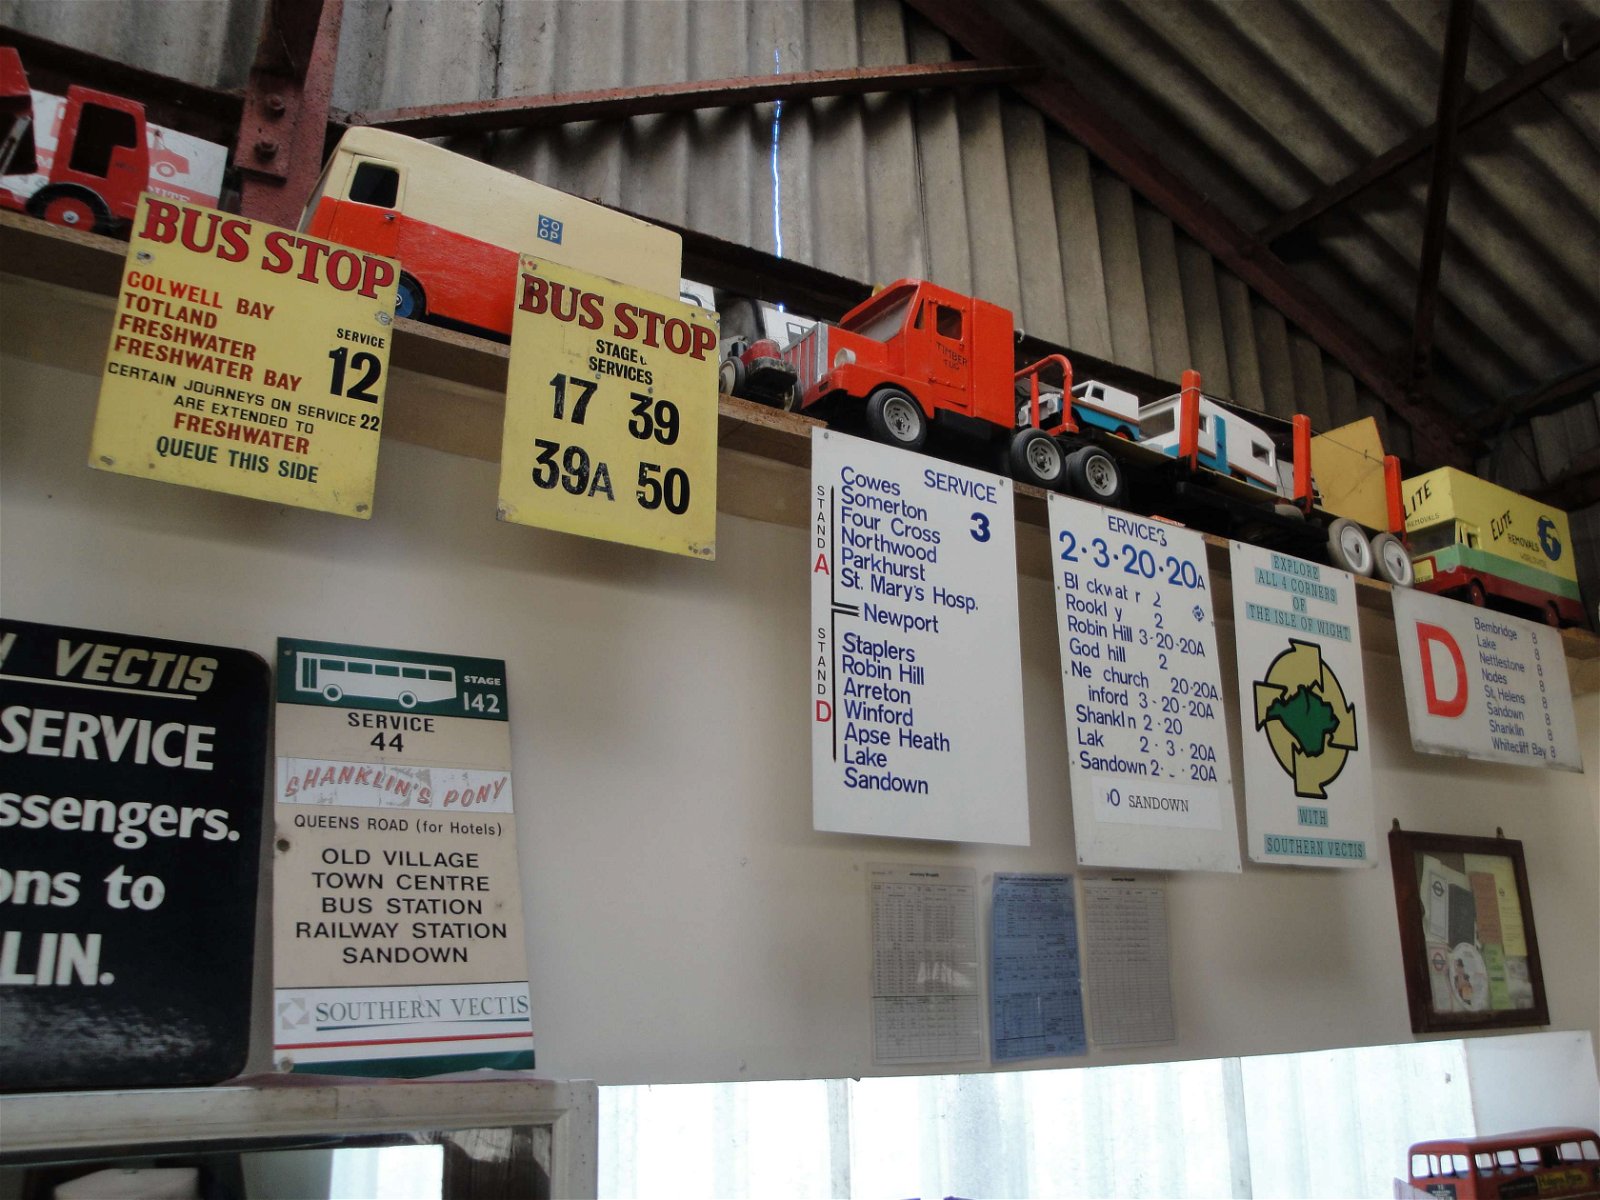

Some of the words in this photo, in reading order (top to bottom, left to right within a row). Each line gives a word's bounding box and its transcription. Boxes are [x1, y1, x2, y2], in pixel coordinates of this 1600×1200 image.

[138, 196, 252, 262] BUS
[261, 230, 394, 300] STOP
[127, 271, 223, 309] COLWELL
[236, 298, 275, 321] BAY
[124, 292, 218, 329] TOTLAND
[519, 273, 605, 331] BUS
[614, 302, 717, 362] STOP
[119, 313, 257, 361] FRESHWATER
[336, 327, 385, 349] SERVICE
[596, 339, 638, 363] STAGE
[114, 334, 254, 382] FRESHWATER
[263, 369, 302, 392] BAY
[328, 346, 382, 404] 12
[589, 356, 653, 385] SERVICES
[108, 362, 177, 387] CERTAIN
[184, 379, 265, 407] JOURNEYS
[271, 398, 291, 412] ON
[297, 404, 356, 427] SERVICE
[360, 413, 381, 432] 22
[549, 372, 598, 425] 17
[173, 395, 205, 411] ARE
[211, 403, 288, 430] EXTENDED
[295, 420, 314, 434] TO
[628, 392, 680, 445] 39
[173, 412, 310, 455] FRESHWATER
[155, 436, 219, 464] QUEUE
[228, 449, 269, 473] THIS
[278, 461, 319, 484] SIDE
[531, 438, 615, 502] 39A
[636, 462, 691, 515] 50
[840, 466, 901, 496] Cowes
[924, 469, 997, 504] SERVICE
[841, 485, 928, 521] Somerton
[841, 506, 881, 530] Four
[891, 518, 941, 544] Cross
[969, 512, 991, 543] 3
[841, 526, 937, 563] Northwood
[1507, 533, 1540, 552] REMOVALS
[814, 553, 830, 575] A
[841, 547, 926, 581] Parkhurst
[1273, 555, 1319, 580] EXPLORE
[840, 568, 864, 590] St.
[871, 576, 925, 602] Mary's
[932, 586, 978, 614] Hosp.
[1258, 569, 1278, 586] ALL
[1281, 576, 1287, 589] 4
[1290, 578, 1336, 602] CORNERS
[1152, 592, 1162, 608] 2
[1292, 597, 1306, 612] OF
[864, 602, 939, 634] Newport
[1067, 615, 1108, 638] Robin
[1113, 624, 1133, 643] Hill
[1154, 613, 1164, 629] 2
[1248, 604, 1271, 622] THE
[1274, 611, 1297, 628] ISLE
[1301, 617, 1314, 631] OF
[1317, 620, 1350, 640] WIGHT
[1474, 617, 1518, 640] Bembridge
[842, 632, 915, 663] Staplers
[1476, 634, 1497, 650] Lake
[55, 638, 219, 692] VECTIS
[842, 654, 892, 680] Robin
[900, 664, 924, 686] Hill
[1158, 653, 1168, 670] 2
[1416, 621, 1468, 718] D
[1479, 650, 1525, 672] Nettlestone
[464, 675, 501, 686] STAGE
[843, 677, 911, 704] Arreton
[1481, 668, 1508, 685] Nodes
[463, 691, 500, 713] 142
[1497, 688, 1525, 704] Helens
[348, 712, 435, 733] SERVICE
[815, 700, 832, 722] D
[844, 699, 914, 727] Winford
[1486, 702, 1524, 720] Sandown
[0, 705, 216, 771] SERVICE
[370, 732, 404, 752] 44
[844, 722, 891, 746] Apse
[899, 728, 950, 752] Heath
[1489, 719, 1524, 737] Shanklin
[844, 744, 887, 768] Lake
[1491, 736, 1529, 755] Whitecliff
[1532, 743, 1547, 759] Bay
[1079, 751, 1147, 776] Sandown
[1190, 764, 1218, 782] 20A
[285, 765, 431, 805] SHANKLIN'S
[443, 776, 508, 808] PONY
[843, 767, 929, 795] Sandown
[1128, 795, 1189, 812] SANDOWN
[1299, 808, 1328, 825] WITH
[294, 814, 360, 830] QUEENS
[367, 818, 409, 832] ROAD
[416, 818, 443, 834] (for
[450, 821, 502, 837] Hotels)
[322, 848, 370, 865] OLD
[383, 850, 479, 868] VILLAGE
[1266, 837, 1324, 855] SOUTHERN
[1327, 841, 1363, 858] VECTIS
[103, 864, 165, 911] to
[312, 872, 383, 890] TOWN
[396, 874, 490, 892] CENTRE
[321, 897, 372, 914] BUS
[386, 898, 482, 915] STATION
[296, 922, 398, 939] RAILWAY
[412, 922, 507, 939] STATION
[342, 947, 468, 964] SANDOWN
[315, 999, 442, 1022] SOUTHERN
[451, 995, 529, 1017] VECTIS
